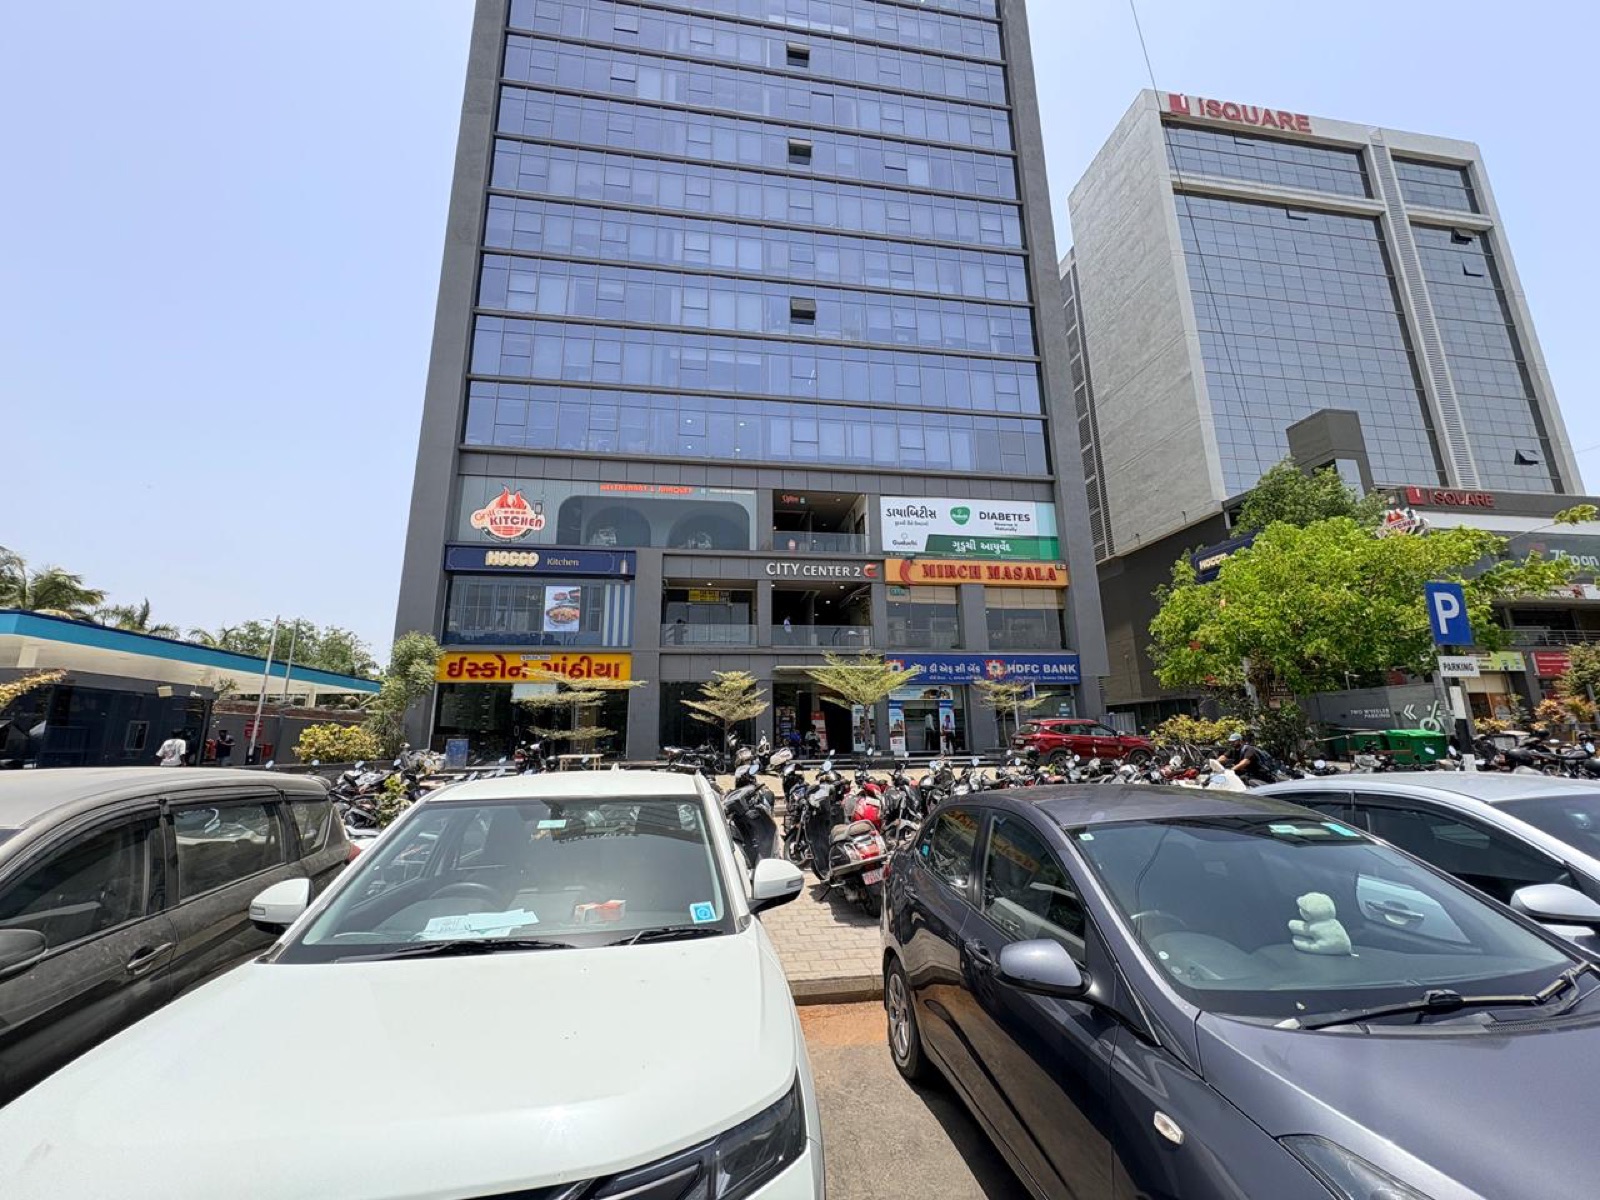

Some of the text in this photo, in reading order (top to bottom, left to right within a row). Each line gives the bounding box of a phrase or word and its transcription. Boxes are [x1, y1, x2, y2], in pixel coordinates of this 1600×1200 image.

[979, 511, 1031, 522] DIABETES
[485, 550, 580, 567] HOCCO Kitchen
[766, 563, 799, 576] CITY
[803, 565, 850, 577] CENTER
[854, 567, 861, 577] 2
[922, 563, 1057, 581] MIRCH MASALA
[1433, 592, 1460, 635] P
[1007, 663, 1077, 674] HDFC BANK
[1442, 661, 1475, 672] PARKING
[1364, 707, 1390, 715] WHEELER
